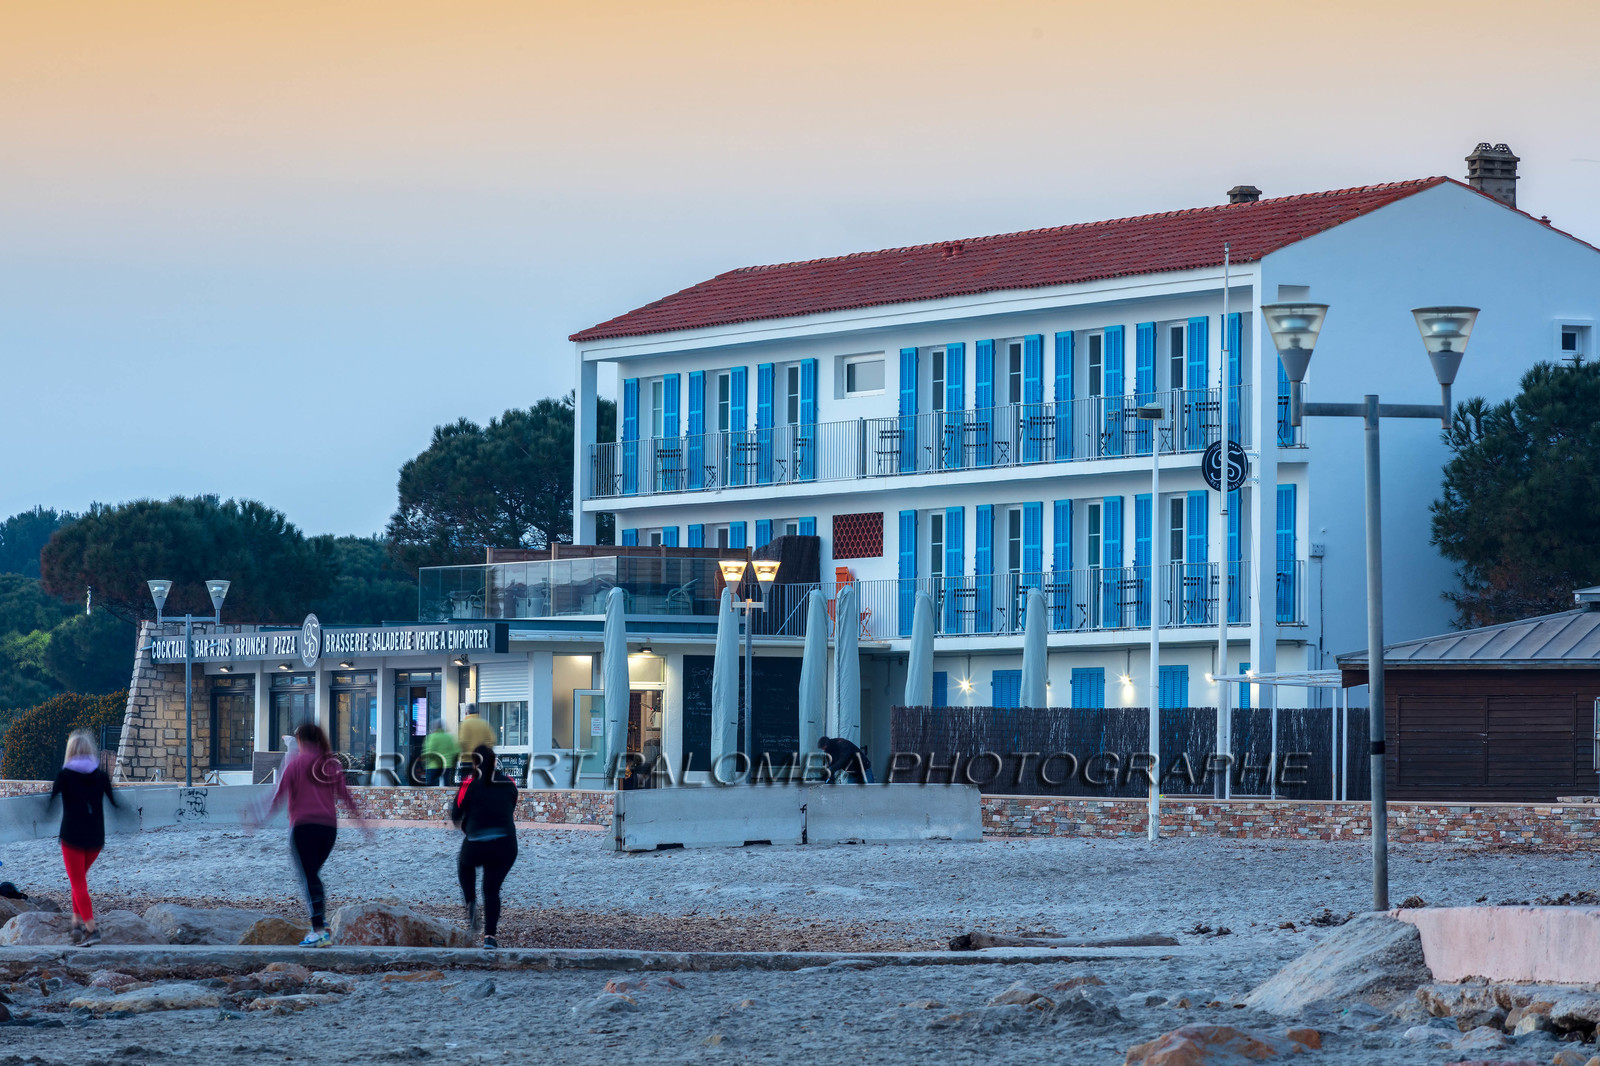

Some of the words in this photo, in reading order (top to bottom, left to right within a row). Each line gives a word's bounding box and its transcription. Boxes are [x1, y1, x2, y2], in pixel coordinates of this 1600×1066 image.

[152, 640, 191, 659] COCKTAIL
[195, 639, 209, 658] BAR
[216, 638, 230, 657] JUS
[235, 636, 266, 656] BRUNCH
[273, 635, 296, 654] PIZZA
[325, 632, 368, 653] BRASSERIE
[372, 631, 412, 651] SALADERIE
[415, 630, 439, 651] VENTE
[448, 628, 489, 650] EMPORTER
